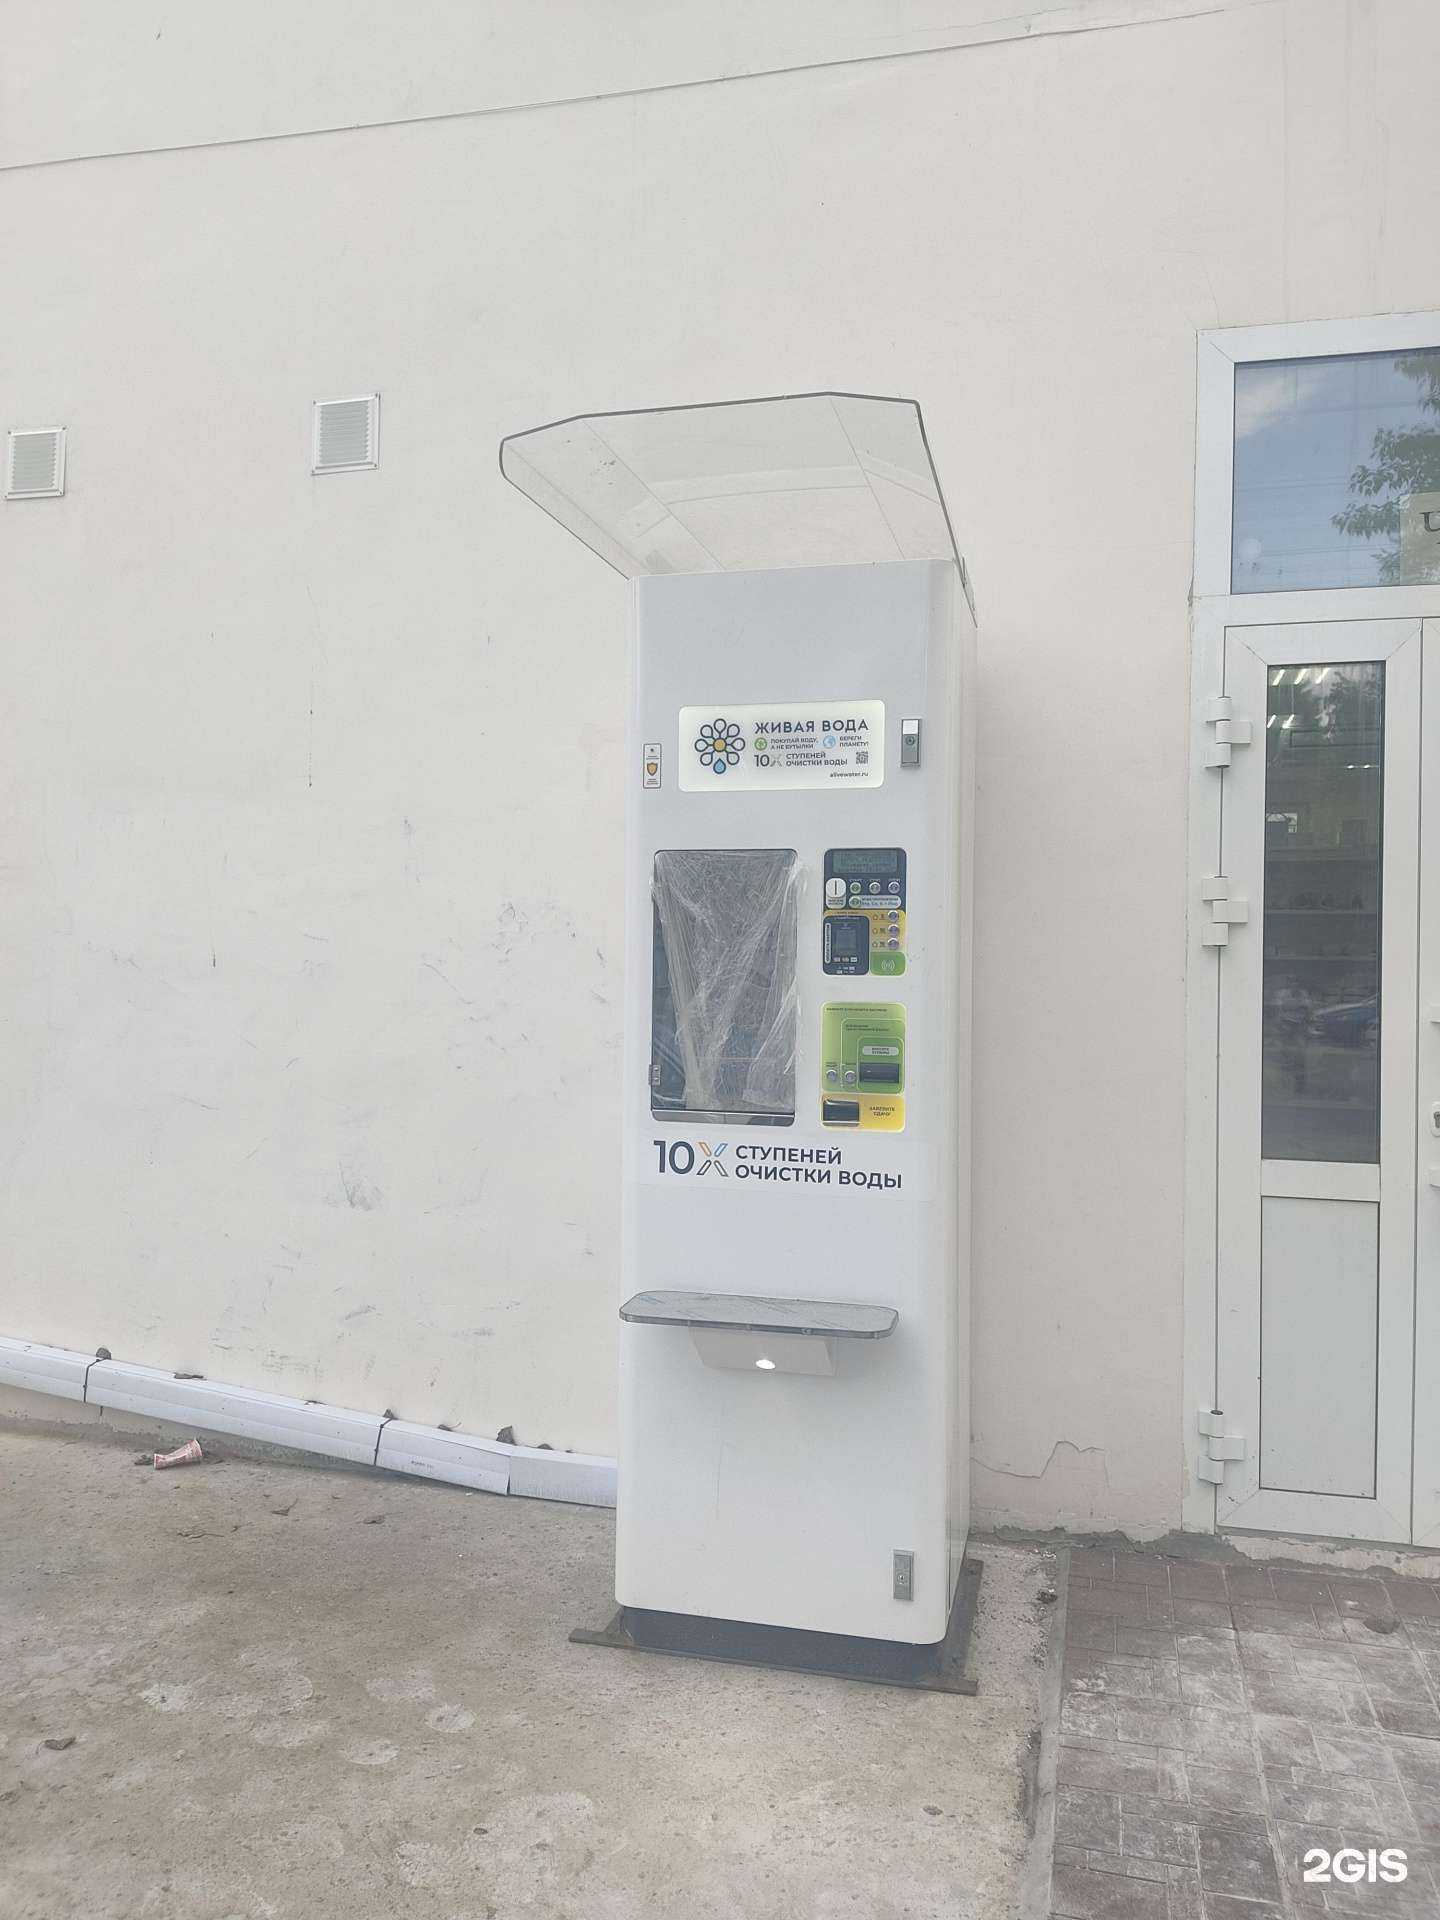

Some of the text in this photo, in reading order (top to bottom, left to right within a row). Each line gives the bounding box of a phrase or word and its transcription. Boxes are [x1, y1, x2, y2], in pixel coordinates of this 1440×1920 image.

[755, 719, 869, 734] ЖИВАЯ ВОДА
[786, 751, 826, 760] СТУПЕНЕЙ
[786, 759, 821, 767] ОЧИСТКИ
[735, 1145, 842, 1165] СТУПЕНЕЙ
[735, 1164, 902, 1190] ОЧИСТКИ ВОДЫ
